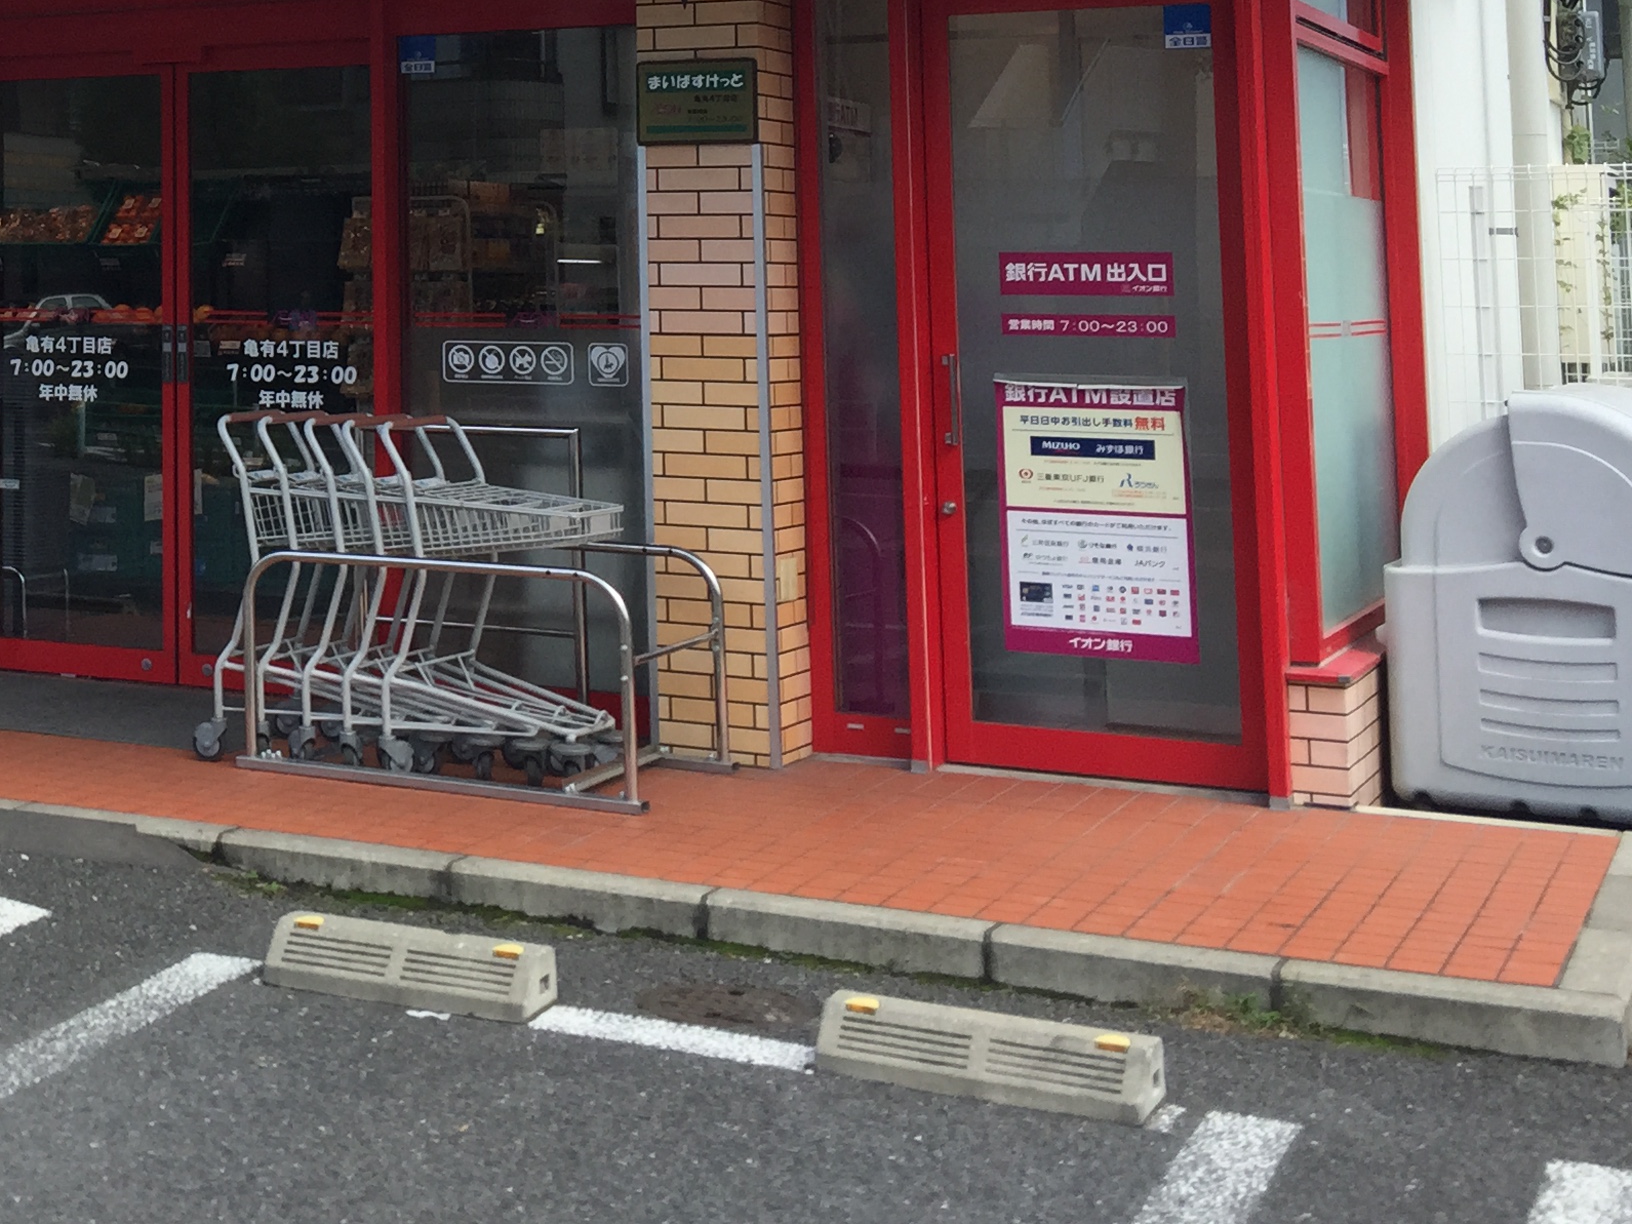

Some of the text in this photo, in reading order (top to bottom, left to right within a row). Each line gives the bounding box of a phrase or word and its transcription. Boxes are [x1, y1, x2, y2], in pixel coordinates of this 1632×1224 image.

[647, 73, 744, 90] まいばすけっと
[1005, 262, 1167, 282] 銀行ATM 出入口
[26, 335, 113, 355] 亀有4丁目店
[243, 338, 340, 360] 亀有4丁目店
[39, 383, 99, 403] 年中無休
[258, 389, 325, 409] 年中無休
[1041, 441, 1081, 451] MIZUHO
[1068, 636, 1133, 653] イオン銀行
